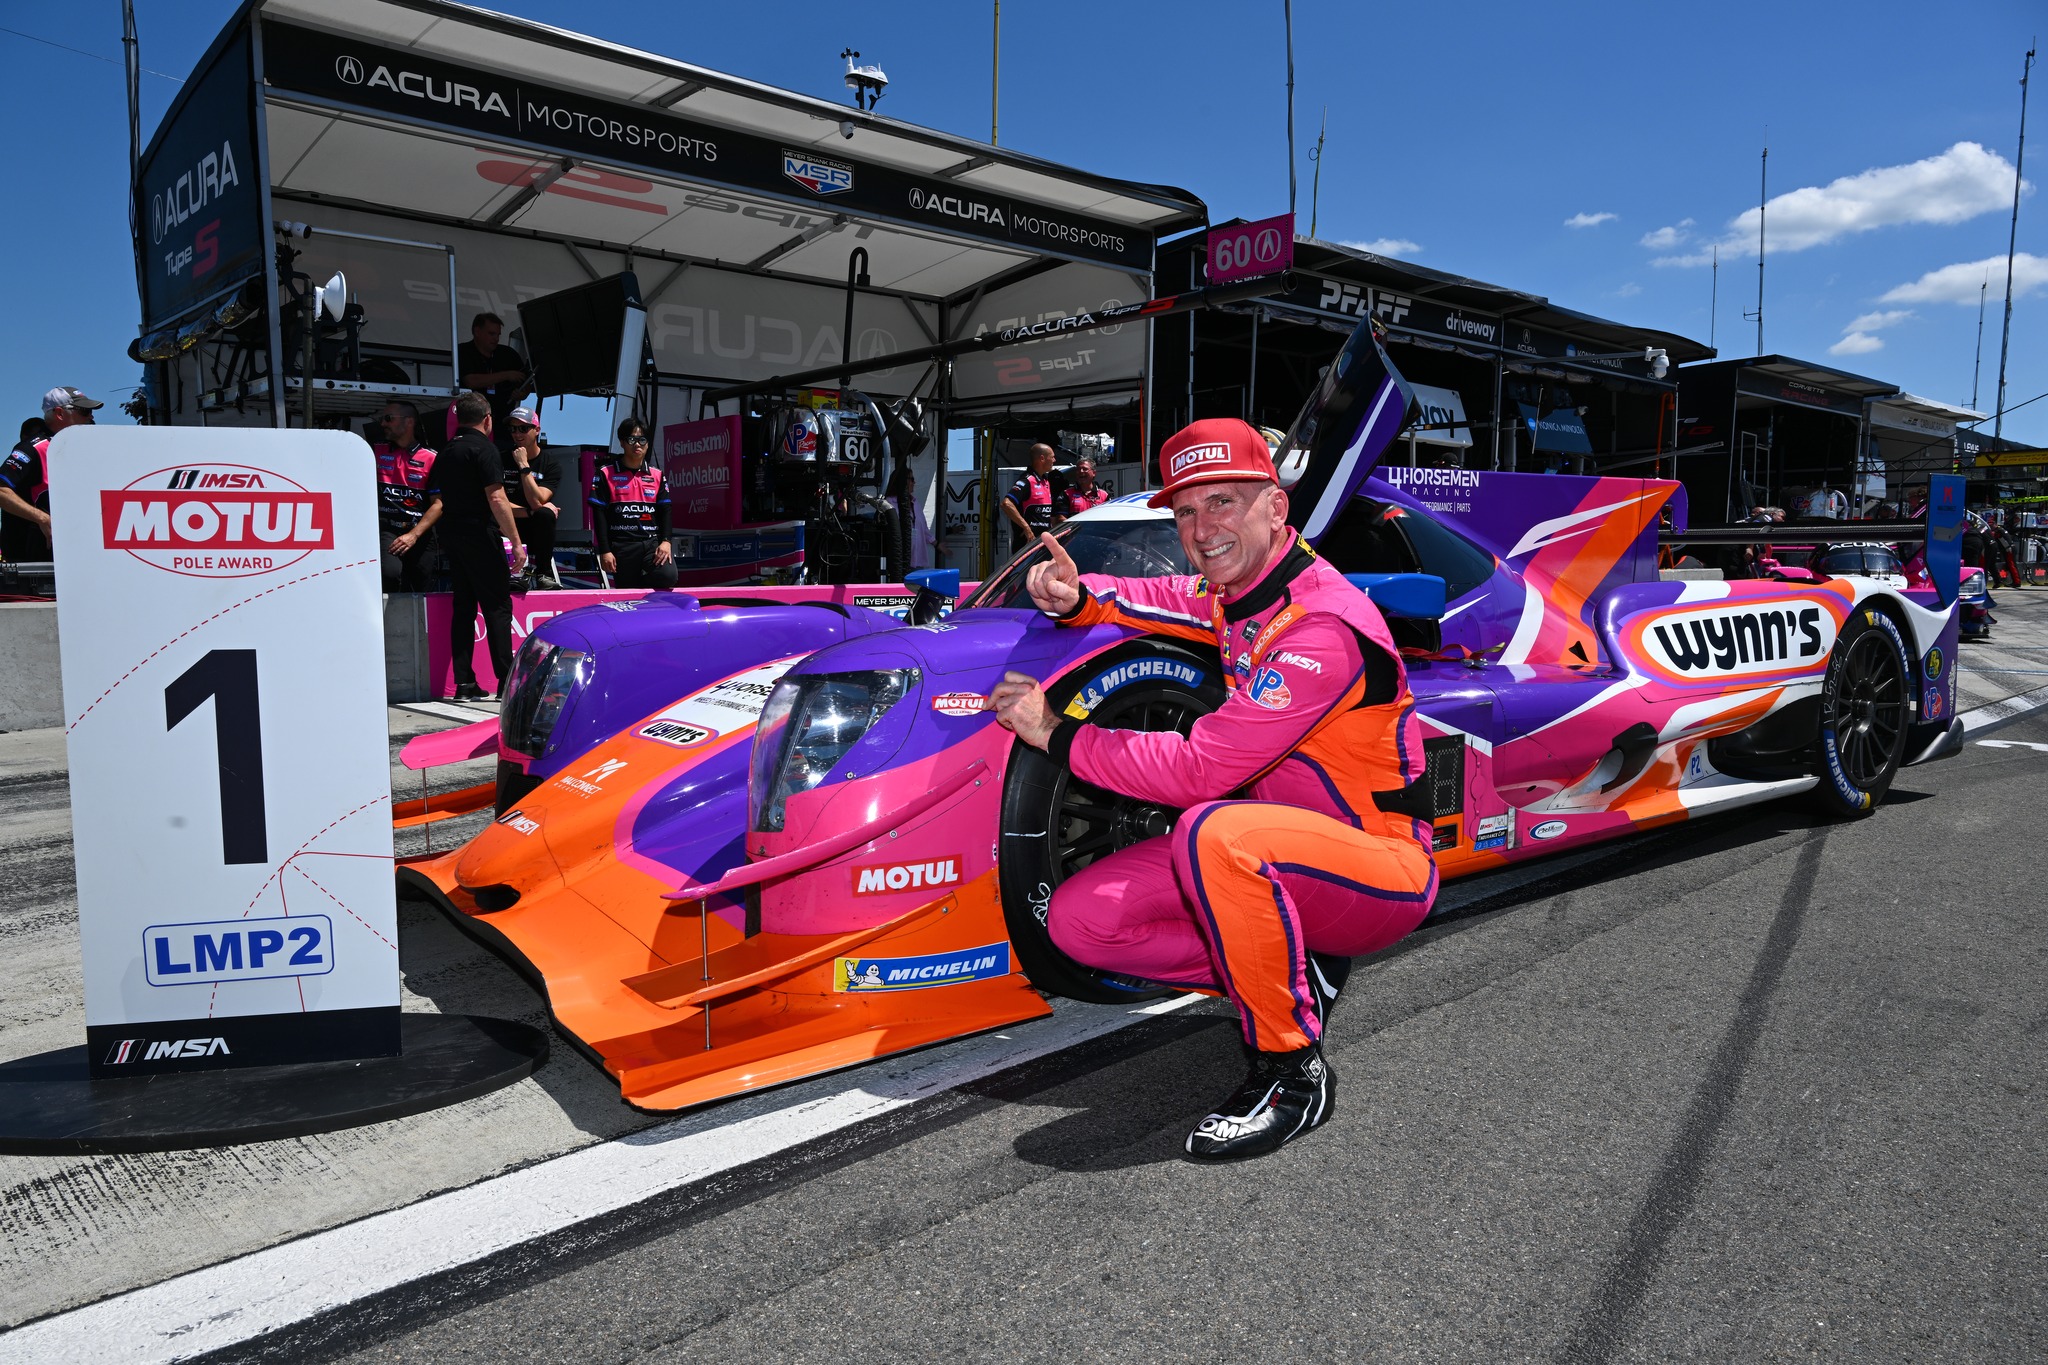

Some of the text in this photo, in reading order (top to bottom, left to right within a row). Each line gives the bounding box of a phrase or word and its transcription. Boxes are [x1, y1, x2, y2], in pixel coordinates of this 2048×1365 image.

[366, 65, 718, 162] ACURA MOTORSPORTS
[784, 151, 852, 171] MEYER SHANK RACING
[786, 159, 851, 186] MSR
[164, 140, 239, 235] ACURA
[925, 193, 1125, 252] ACURA MOTORSPORTS
[165, 218, 221, 279] Type S
[1215, 235, 1251, 271] 60
[1320, 280, 1412, 324] PFAFF
[1016, 314, 1096, 338] ACURA
[1102, 304, 1142, 316] Type
[1446, 310, 1496, 342] driveway
[1517, 343, 1538, 355] ACURA
[1789, 381, 1825, 394] CORVETTE
[1539, 421, 1585, 434] KONICA MINOLTA
[845, 436, 870, 462] 60
[1175, 447, 1225, 470] MOTUL
[199, 473, 266, 488] IMSA
[668, 464, 731, 488] AutoNation
[1412, 487, 1471, 497] RACING
[622, 504, 656, 513] ACURA
[1456, 502, 1471, 512] PARTS
[114, 500, 324, 543] MOTUL
[173, 556, 273, 569] POLE AWARD
[856, 597, 916, 606] MEYER SHAN
[1253, 612, 1293, 654] sparco
[1880, 613, 1910, 673] MICHELIN
[1101, 661, 1197, 693] MICHELIN
[1278, 652, 1323, 675] IMSA
[1250, 667, 1285, 702] VP
[1262, 690, 1287, 704] Racing
[165, 648, 268, 865] 1
[1690, 752, 1701, 776] P2
[1827, 738, 1859, 805] MICHELIN
[508, 817, 540, 836] IMSA
[857, 859, 959, 893] MOTUL
[154, 926, 324, 976] LMP2
[887, 955, 997, 982] MICHELIN
[143, 1037, 231, 1061] IMSA
